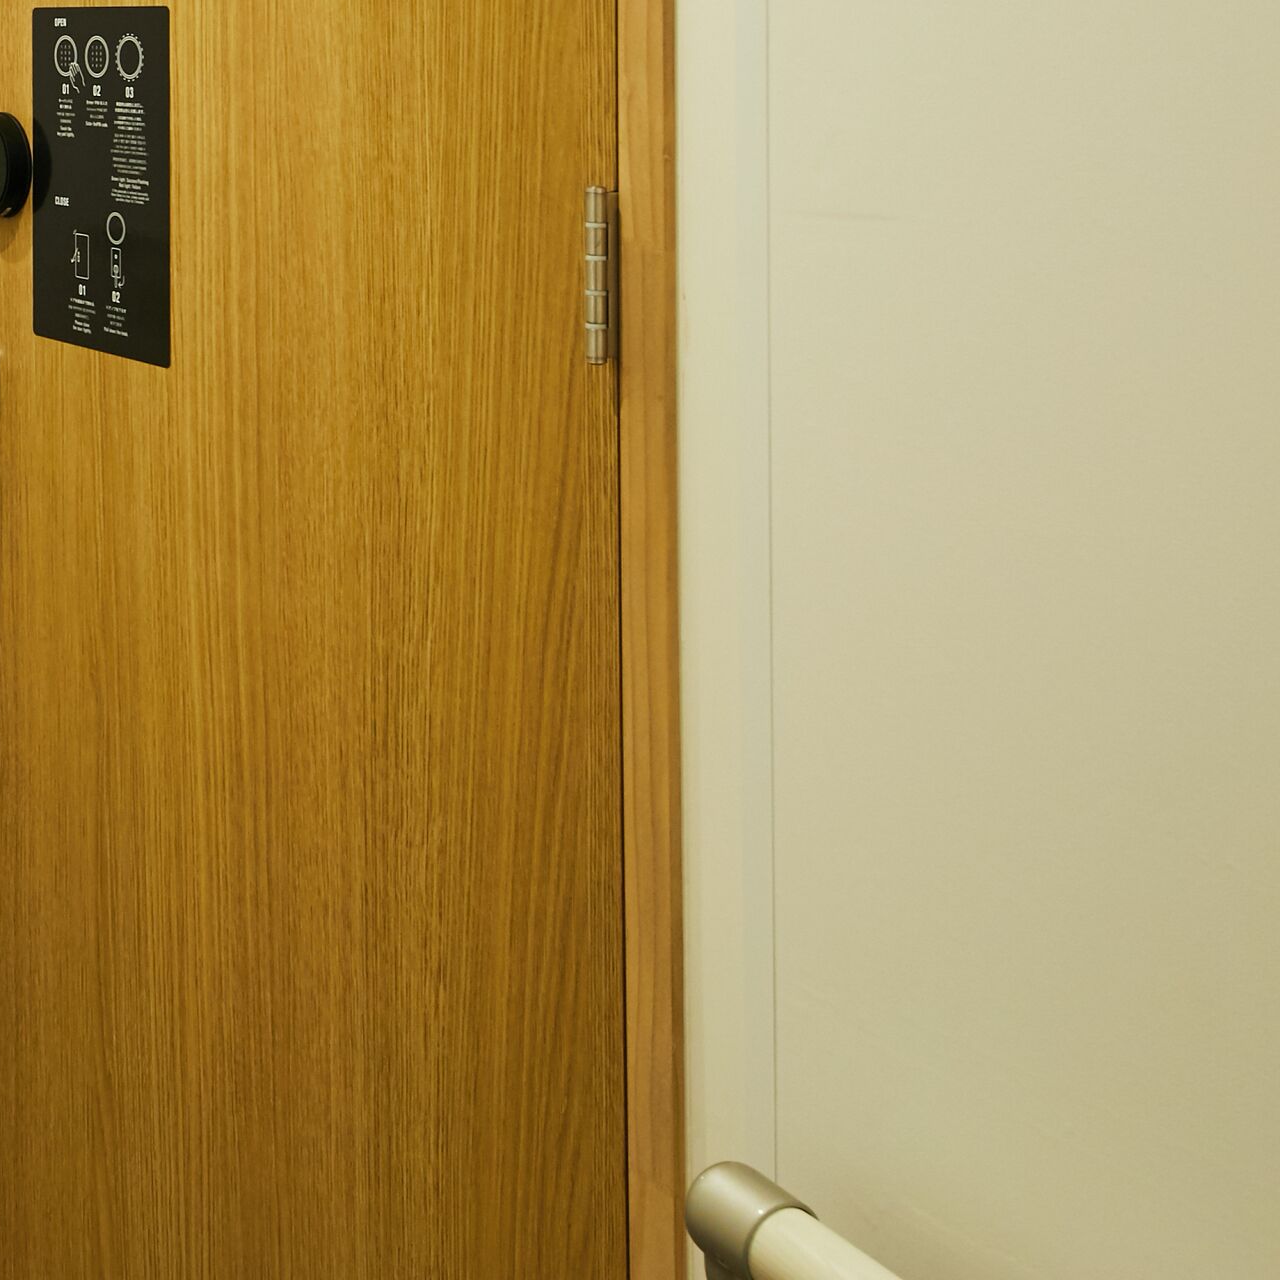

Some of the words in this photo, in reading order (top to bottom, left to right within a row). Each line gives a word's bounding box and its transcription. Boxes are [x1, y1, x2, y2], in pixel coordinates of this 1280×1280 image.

[54, 17, 67, 27] OPEN
[62, 83, 70, 95] 01
[92, 84, 101, 97] 02
[125, 86, 134, 99] 03
[54, 195, 70, 207] CLOSE
[78, 283, 86, 296] 01
[111, 290, 121, 304] 02
